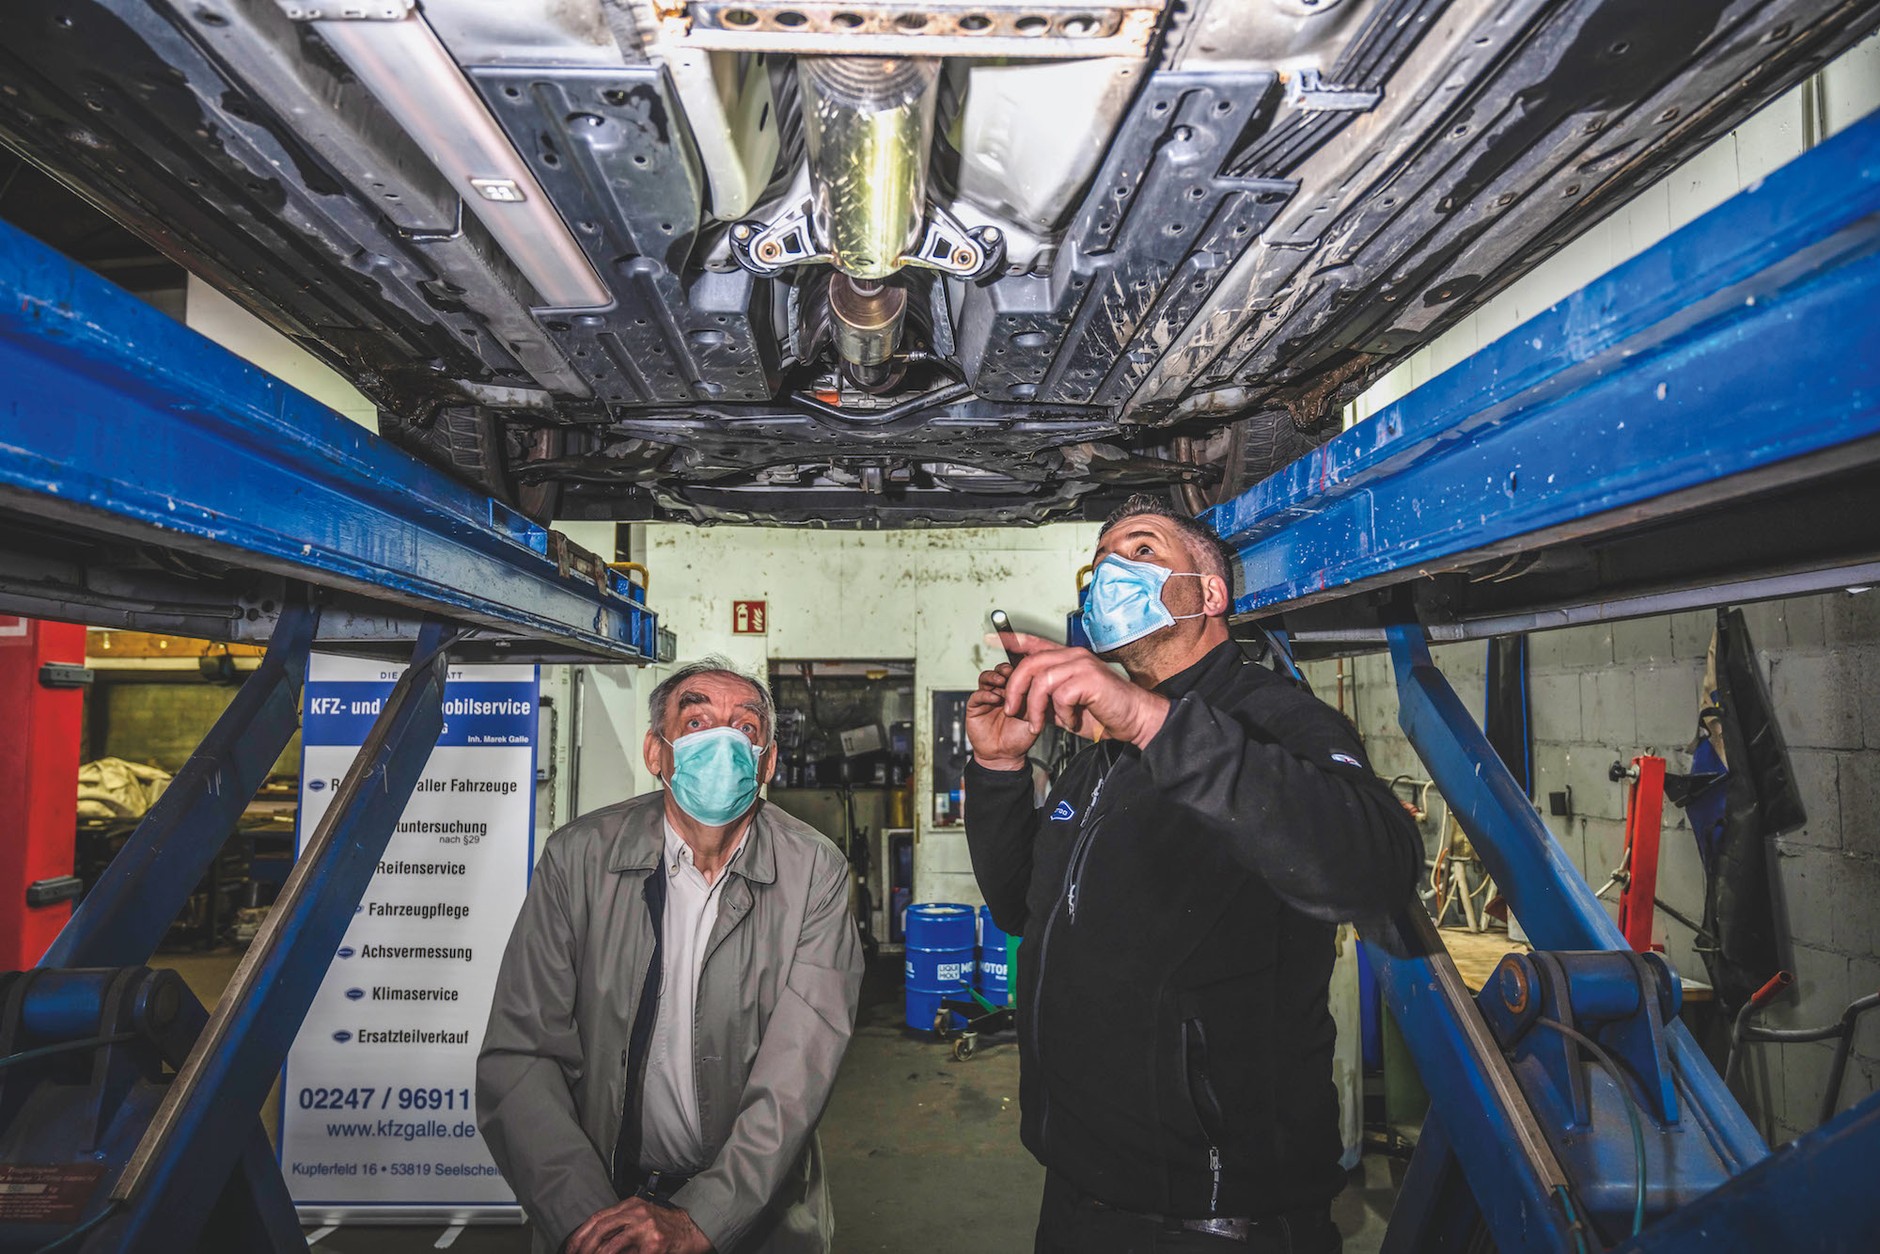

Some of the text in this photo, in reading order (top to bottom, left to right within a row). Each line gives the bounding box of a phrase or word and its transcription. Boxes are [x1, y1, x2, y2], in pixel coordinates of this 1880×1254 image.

[380, 671, 398, 679] DIE
[311, 698, 531, 715] KFZ- und obilservice
[467, 735, 529, 743] Inh. Marek Galle
[417, 779, 518, 795] aller Fahrzeuge
[396, 820, 487, 836] tuntersuchung
[439, 835, 480, 846] nach §29
[376, 861, 466, 875] Reifenservice
[369, 902, 469, 919] Fahrzeugpflege
[361, 945, 472, 961] Achsvermessung
[372, 987, 459, 1001] Klimaservice
[357, 1030, 469, 1044] Ersatzteilverkauf
[299, 1087, 469, 1110] 02247 / 96911
[326, 1120, 475, 1141] www.kfzgalle.de
[292, 1162, 357, 1176] Kupferfeld
[362, 1163, 378, 1176] 16
[390, 1163, 432, 1176] 53819
